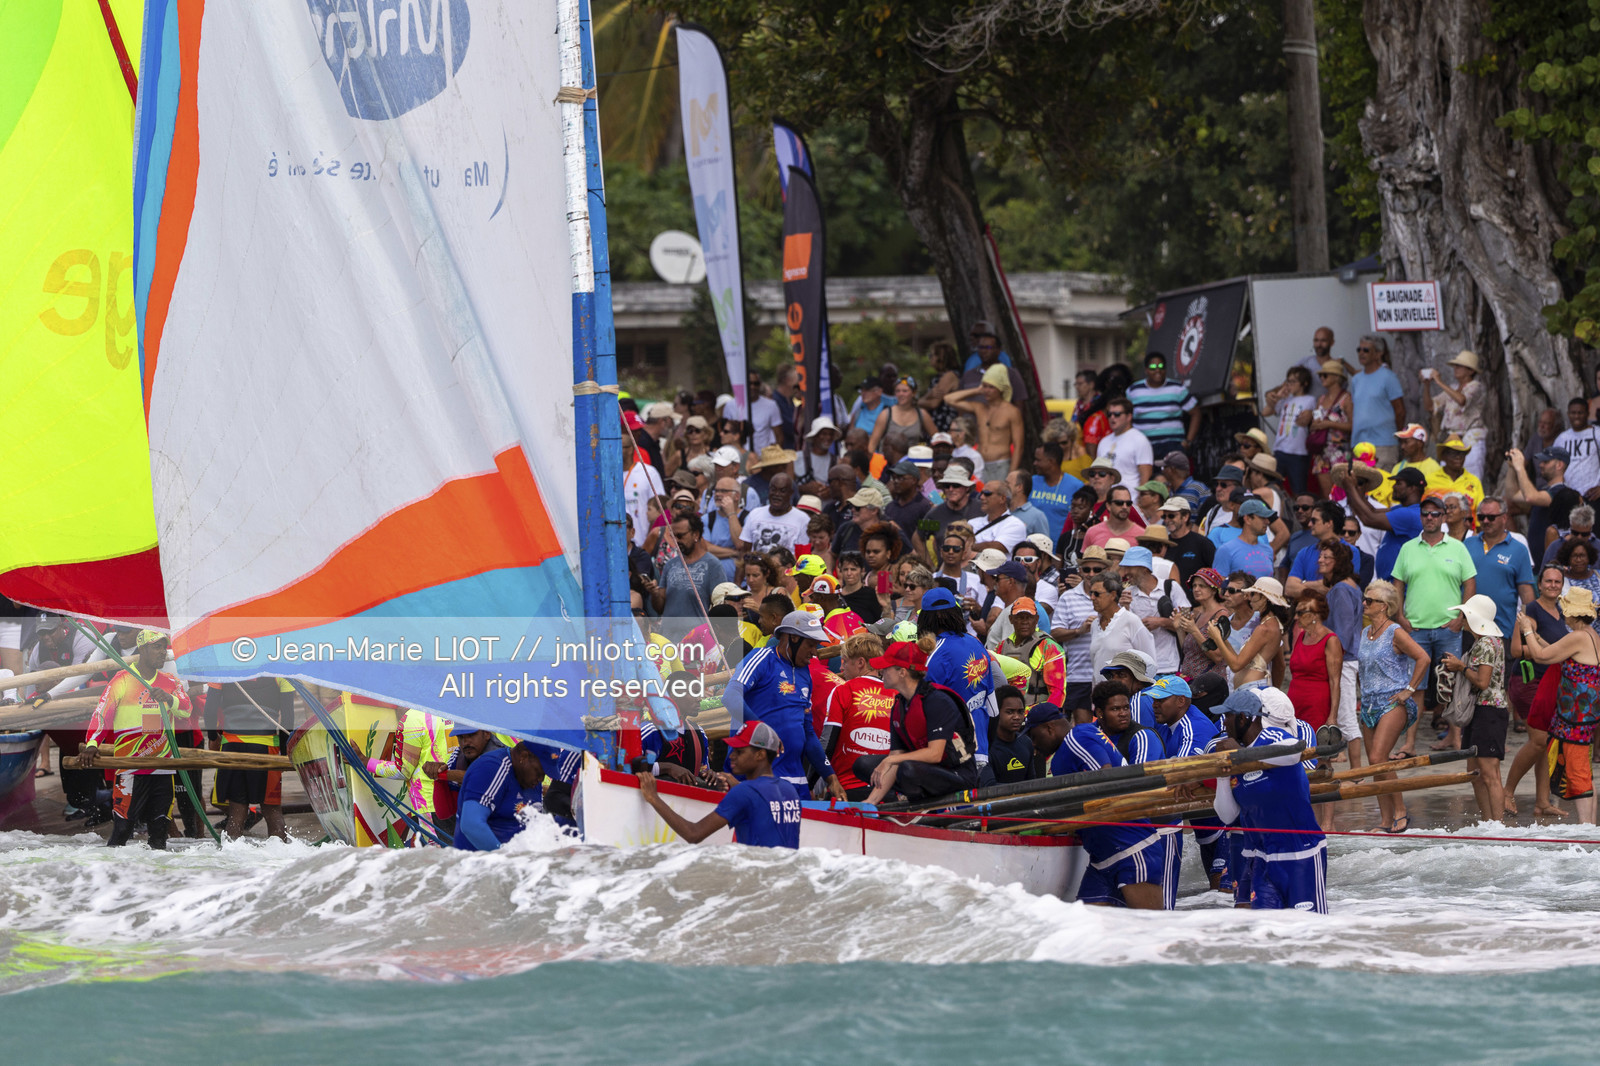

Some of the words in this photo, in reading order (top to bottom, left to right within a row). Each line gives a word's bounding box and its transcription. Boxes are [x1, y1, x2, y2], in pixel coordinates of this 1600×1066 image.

[1386, 289, 1423, 303] BAIGNADE
[1376, 308, 1393, 322] NON
[1394, 304, 1436, 322] SURVEILLÉE
[860, 694, 894, 710] Zapett
[769, 800, 780, 811] BB
[782, 799, 800, 811] YOLE
[771, 811, 780, 824] TI
[783, 810, 800, 824] MAS
